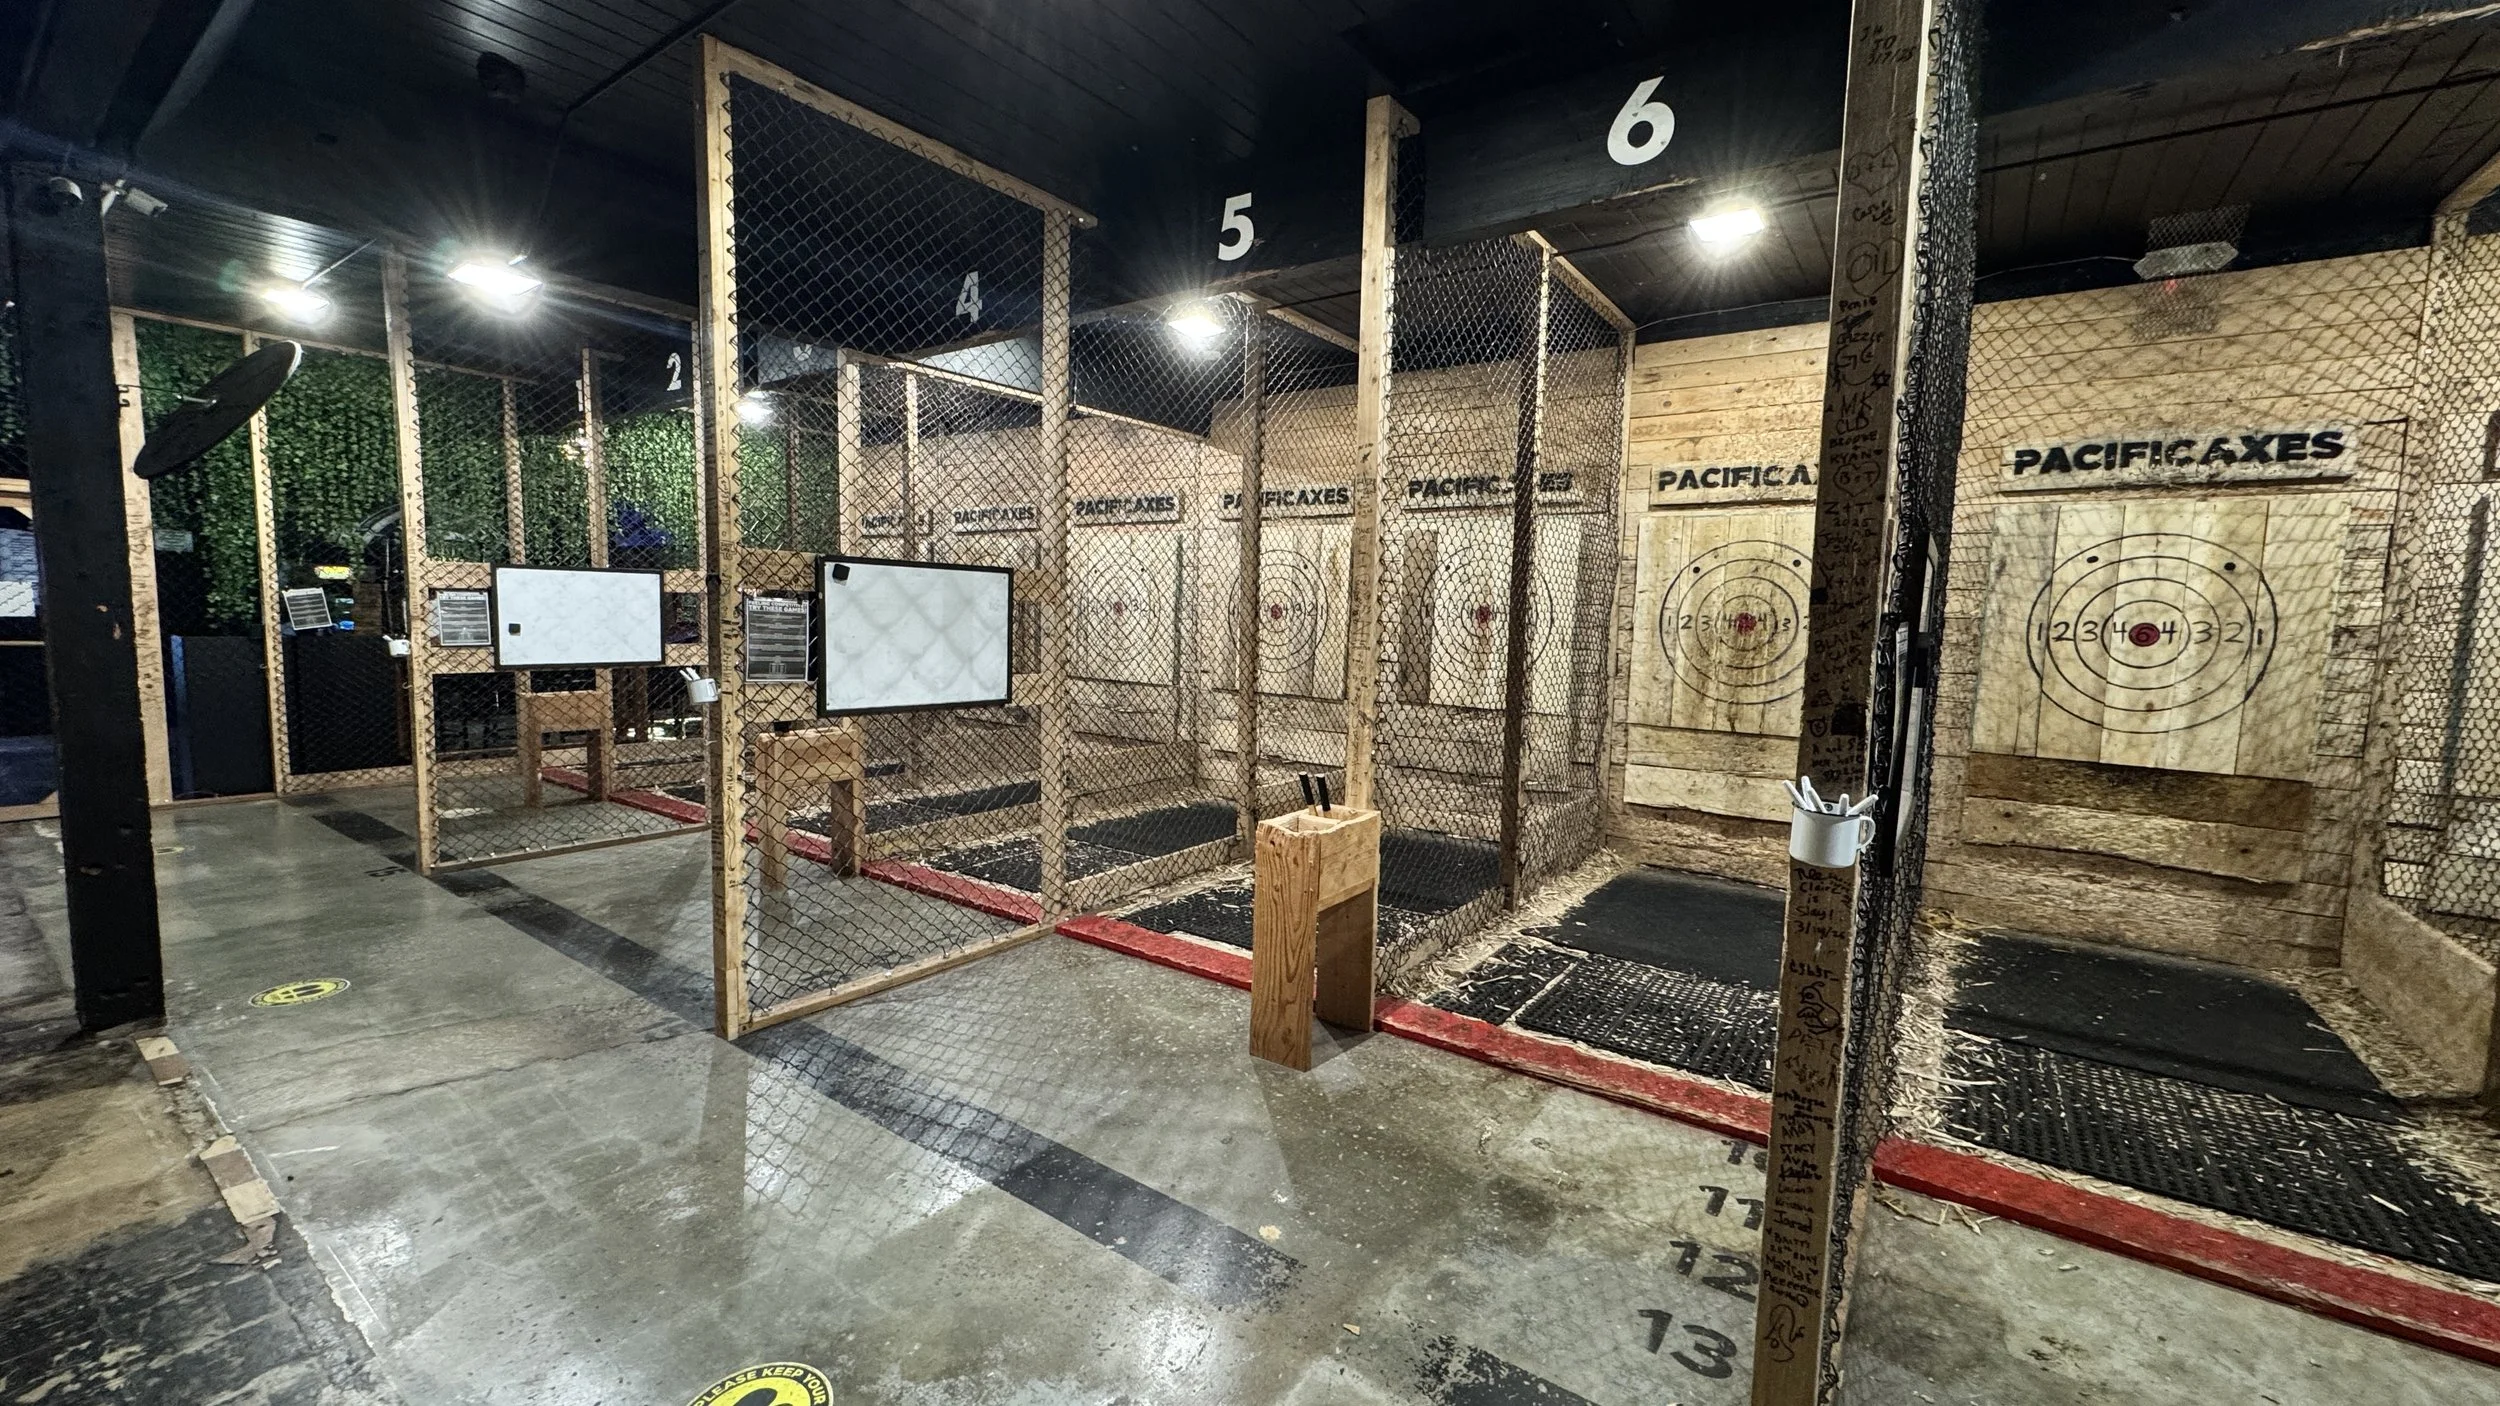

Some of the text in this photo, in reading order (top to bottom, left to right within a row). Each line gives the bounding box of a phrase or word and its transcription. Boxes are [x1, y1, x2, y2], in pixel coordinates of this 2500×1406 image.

[1607, 76, 1675, 165] 6
[1218, 192, 1254, 261] 5
[956, 271, 982, 322] 4
[666, 352, 682, 391] 2
[1657, 464, 1819, 492] PACIFICA
[2037, 622, 2044, 642] 1
[2051, 621, 2076, 642] 2
[2081, 620, 2099, 642] 3
[2113, 621, 2128, 645] 4
[2160, 621, 2178, 645] 4
[2192, 621, 2213, 644] 3
[2223, 621, 2244, 643] 2
[1699, 1185, 1764, 1231] 11
[1669, 1240, 1759, 1303] 12
[1638, 1308, 1738, 1379] 13
[762, 1366, 804, 1378] KEEP
[802, 1373, 827, 1405] YOUR
